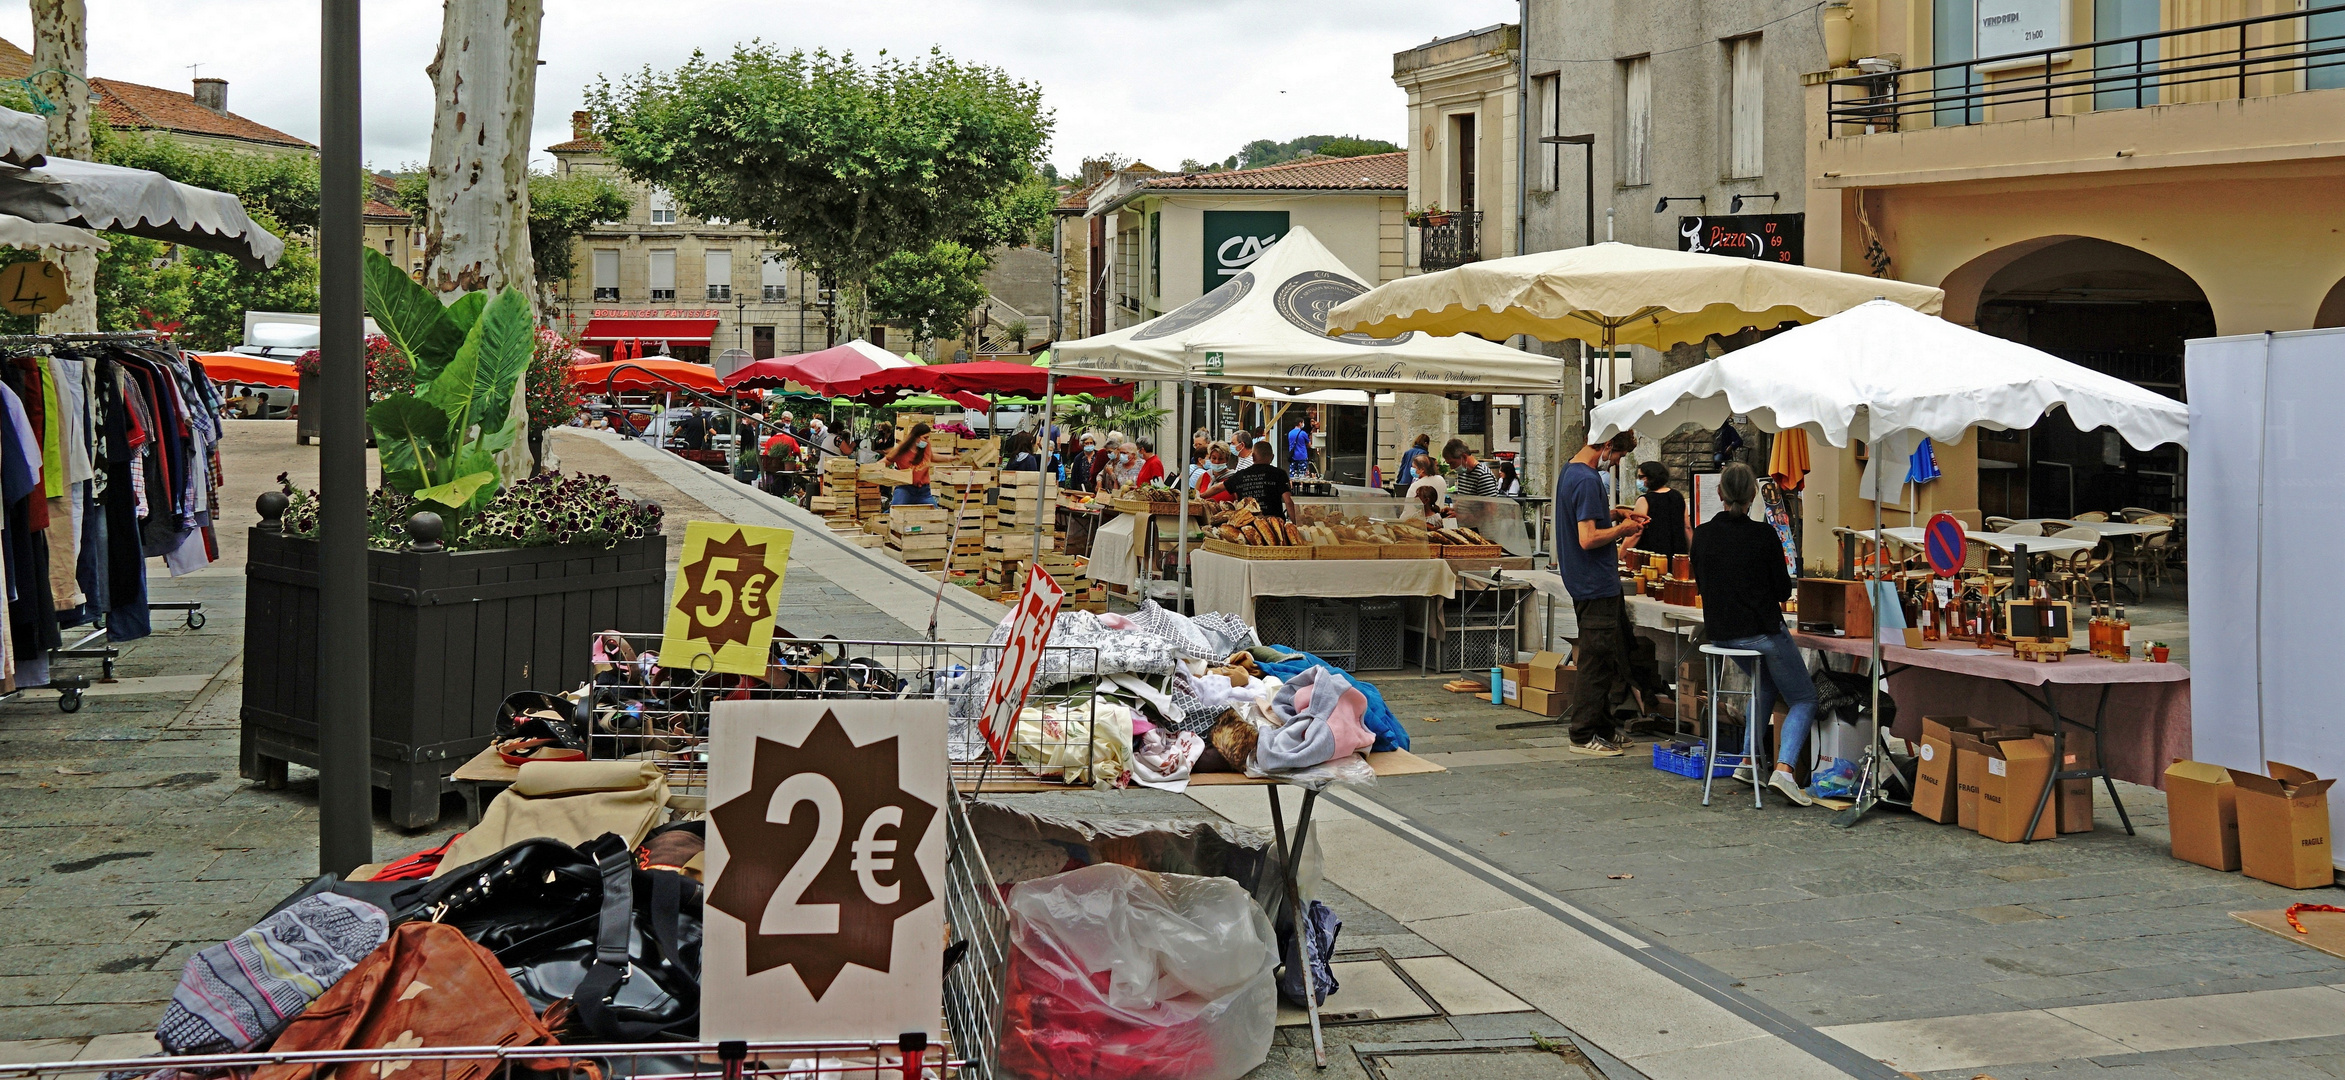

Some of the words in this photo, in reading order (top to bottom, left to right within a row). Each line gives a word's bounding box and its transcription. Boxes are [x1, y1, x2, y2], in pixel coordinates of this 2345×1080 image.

[1982, 12, 2020, 27] VENDREDI
[1765, 222, 1778, 234] 07
[1710, 226, 1747, 247] Pizza
[1770, 235, 1783, 247] 69
[1778, 250, 1791, 262] 30
[594, 309, 659, 318] BOULANGER
[664, 309, 720, 318] PATISSIER
[1287, 364, 1336, 379] Maison
[1340, 361, 1407, 379] Barrailler
[1412, 369, 1440, 381] Artisan
[1444, 370, 1482, 384] Boulanger
[695, 556, 767, 628] 5€
[1921, 773, 1939, 786] FRAGILE
[1984, 792, 2001, 804] FRAGILE
[2070, 788, 2086, 796] FRAGILE
[2301, 837, 2324, 847] FRAGILE
[758, 771, 904, 936] 2€
